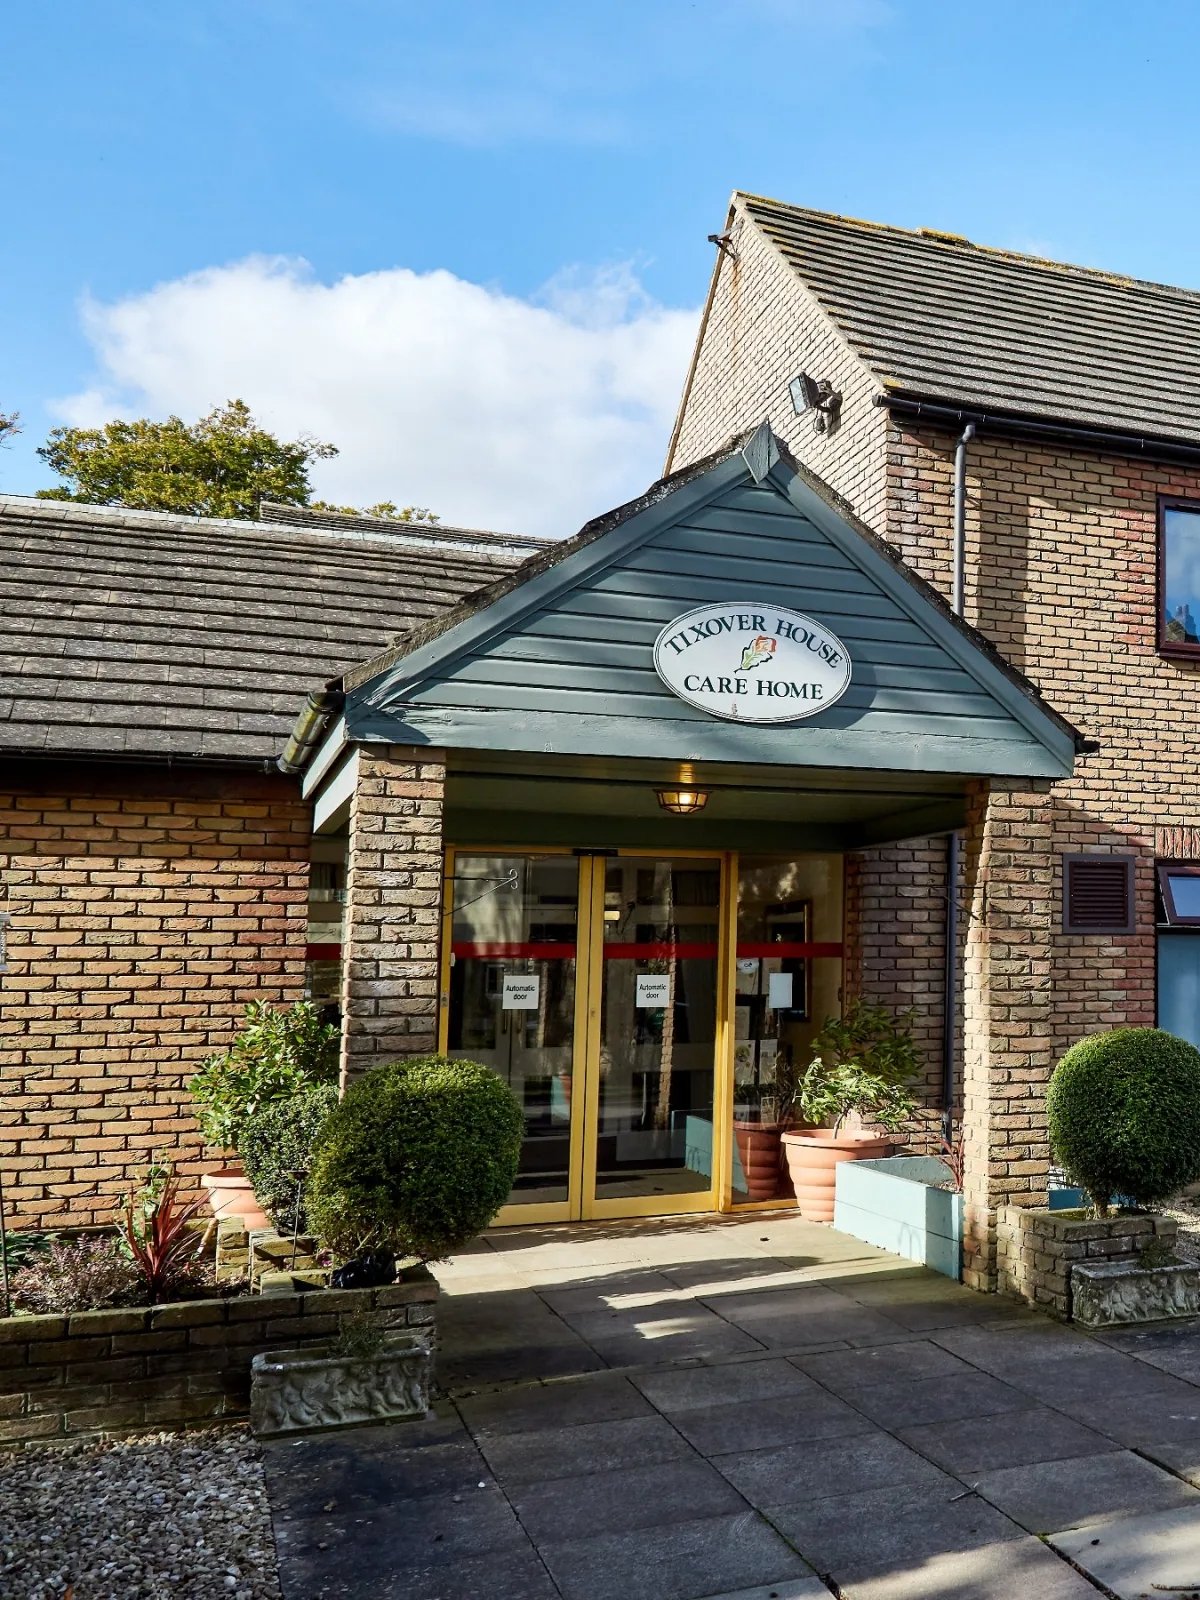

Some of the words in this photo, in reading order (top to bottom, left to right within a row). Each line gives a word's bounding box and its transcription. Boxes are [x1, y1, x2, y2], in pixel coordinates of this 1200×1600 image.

[664, 614, 766, 655] TIXOVER
[774, 618, 843, 668] HOUSE
[684, 675, 748, 695] CARE
[755, 680, 824, 700] HOME
[505, 984, 536, 992] Automatic
[638, 983, 667, 991] Automatic
[645, 991, 660, 999] door
